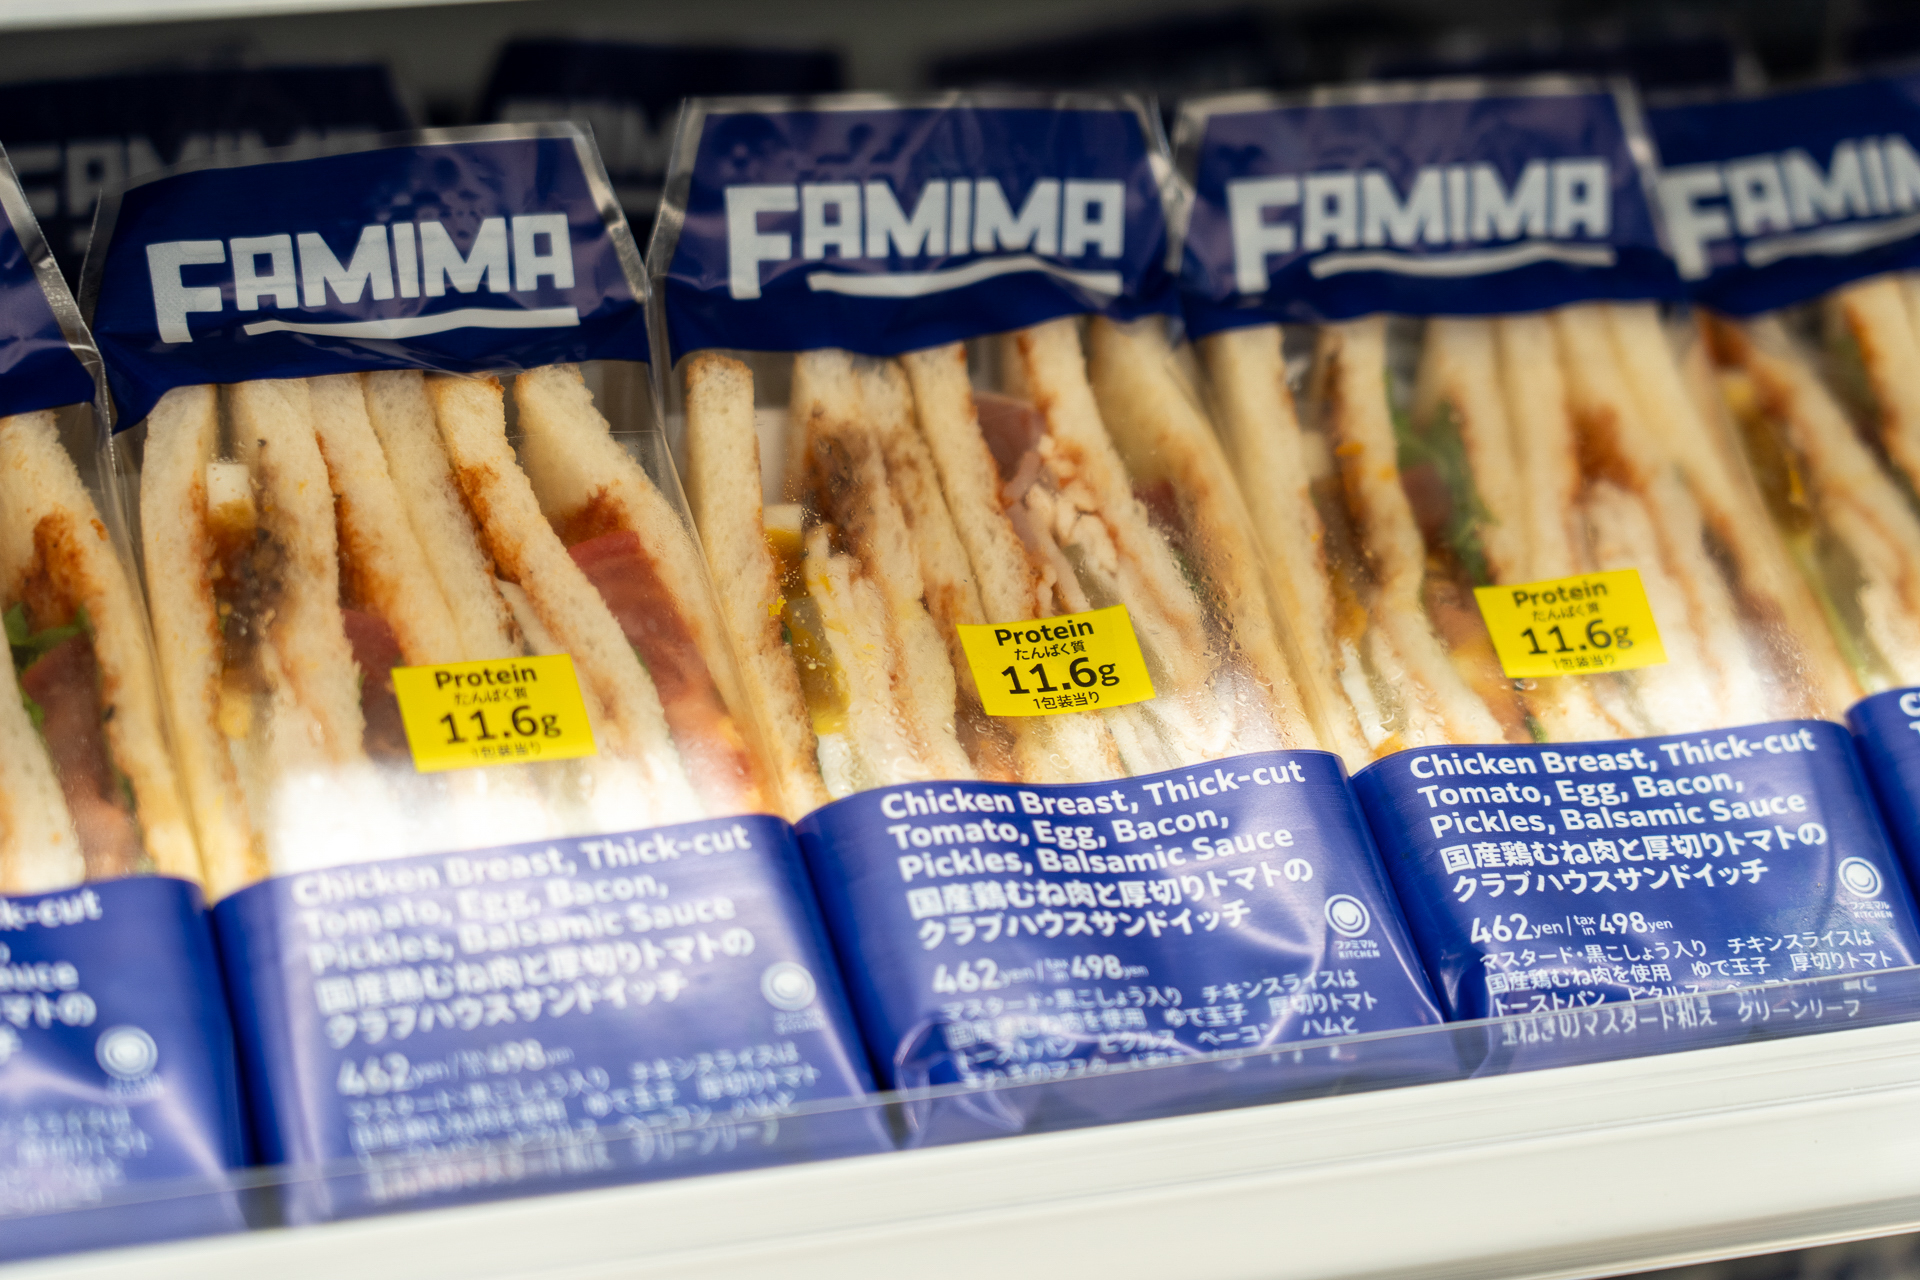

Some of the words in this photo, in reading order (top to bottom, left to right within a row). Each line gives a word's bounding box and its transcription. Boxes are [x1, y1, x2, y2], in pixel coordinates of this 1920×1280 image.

[725, 178, 1125, 300] FAMIMA
[1227, 158, 1611, 294] FAMIMA
[146, 212, 576, 344] FAMIMA
[1512, 580, 1609, 608] Protein
[994, 619, 1095, 646] Protein
[1014, 640, 1087, 661] たんぱく質
[1520, 619, 1634, 656] 11.6g
[434, 663, 538, 691] Protein
[1001, 656, 1120, 695] 11.6g
[1033, 691, 1100, 710] 1包装当り
[440, 705, 562, 745] 11.6g
[1410, 751, 1538, 780] Chicken
[1541, 748, 1658, 776] Breast,
[1660, 727, 1816, 768] Thick-cut
[880, 786, 1015, 819] Chicken
[1017, 789, 1139, 816] Breast,
[1142, 759, 1306, 807] Thick-cut
[1417, 784, 1552, 809] Tomato,
[1556, 778, 1630, 806] Egg,
[1632, 772, 1744, 799] Bacon,
[887, 818, 1030, 850] Tomato,
[1033, 819, 1107, 851] Egg,
[1111, 807, 1230, 844] Bacon,
[1430, 810, 1556, 840] Pickles,
[1561, 802, 1704, 834] Balsamic
[1709, 793, 1807, 822] Sauce
[292, 862, 441, 907] Chicken
[444, 847, 577, 888] Breast,
[580, 824, 752, 870] Thick-cut
[898, 847, 1033, 883] Pickles,
[1036, 841, 1187, 875] Balsamic
[1191, 826, 1295, 861] Sauce
[1440, 821, 1828, 876] 国産鶏むね肉と厚切りトマトの
[906, 856, 1315, 919] 国産鶏むね肉と厚切りトマトの
[1452, 858, 1769, 903] クラブハウスサンドイッチ
[303, 896, 454, 939] Tomato,
[545, 872, 669, 909] Bacon,
[458, 911, 624, 955] Balsamic
[626, 896, 736, 933] Sauce
[917, 897, 1252, 950] クラブハウスサンドイッチ
[1573, 914, 1596, 926] tax
[1583, 925, 1596, 936] in
[1727, 929, 1875, 954] チキンスライスは
[1485, 963, 1672, 995] 国産鶏むね肉を使用
[1691, 956, 1771, 979] ゆで玉子
[1790, 950, 1893, 972] 厚切りトマト
[1495, 990, 1605, 1017] トーストパン
